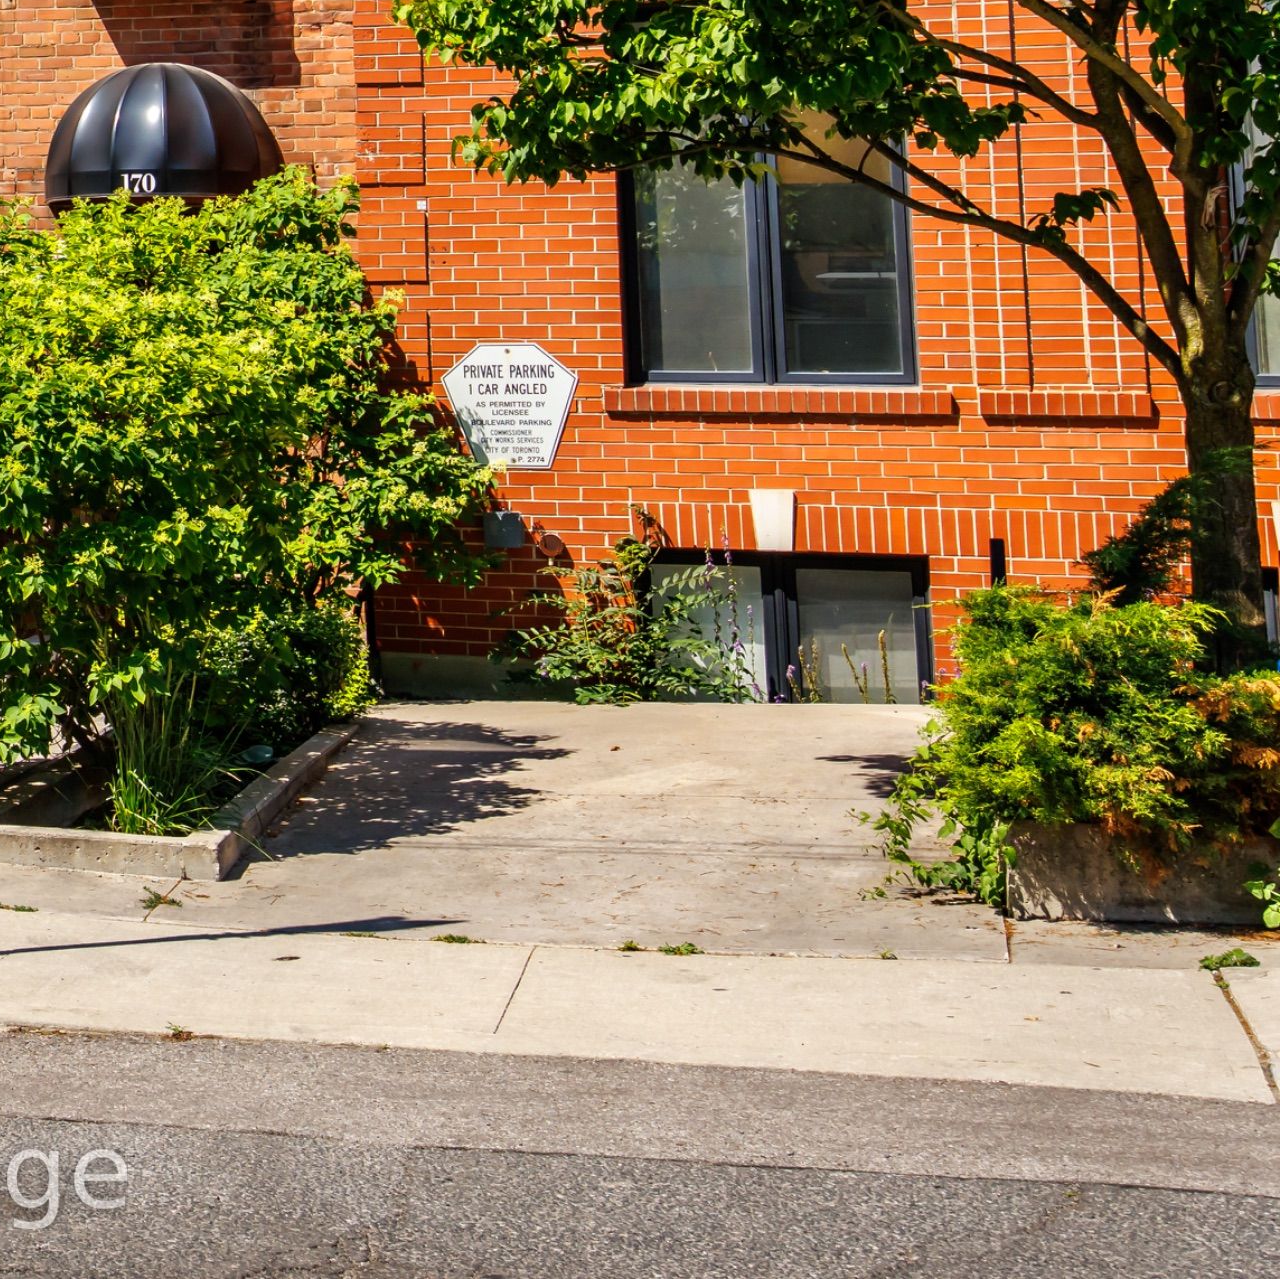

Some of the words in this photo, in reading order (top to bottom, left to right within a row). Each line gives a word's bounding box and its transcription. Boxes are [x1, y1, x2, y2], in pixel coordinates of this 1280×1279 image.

[121, 173, 156, 194] 170
[463, 365, 503, 379] PRIVATE
[509, 365, 555, 379] PARKING
[468, 384, 472, 395] 1
[478, 384, 499, 395] CAR
[504, 384, 547, 395] ANGLED
